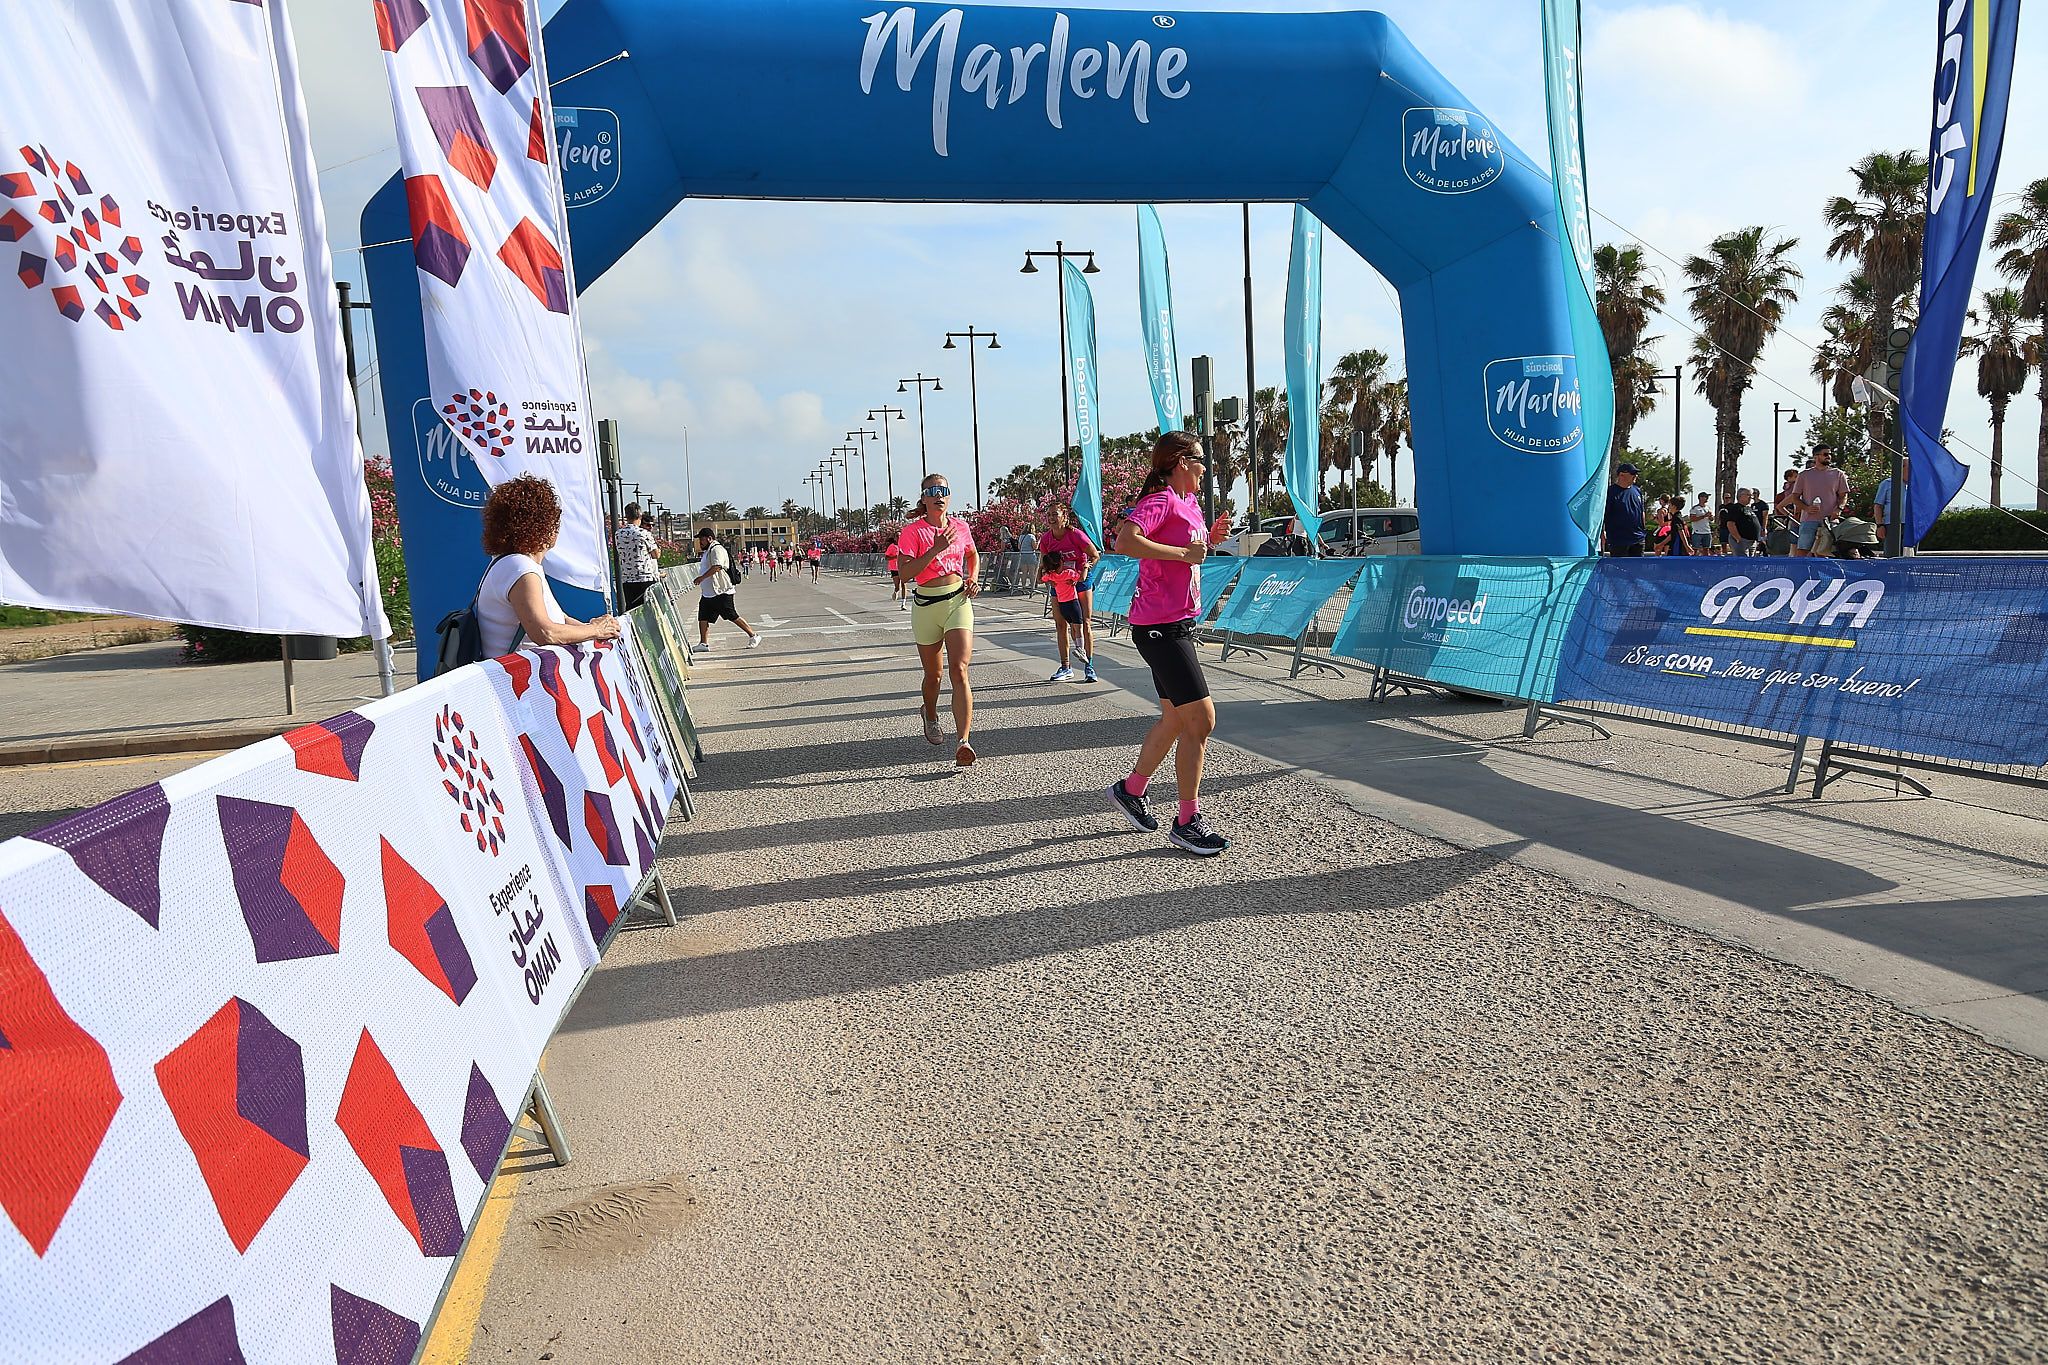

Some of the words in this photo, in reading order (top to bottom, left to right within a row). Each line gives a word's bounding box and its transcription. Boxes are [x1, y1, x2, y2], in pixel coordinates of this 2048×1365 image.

[859, 6, 1191, 157] Marlene
[558, 128, 612, 172] lene
[1411, 126, 1496, 171] Marlene
[573, 182, 604, 201] ALPES
[1416, 170, 1435, 186] HIJA
[1437, 179, 1450, 188] DE
[1451, 179, 1469, 188] LOS
[1471, 167, 1495, 185] ALPES
[1504, 428, 1525, 444] HIJA
[1528, 438, 1541, 447] DE
[1544, 438, 1561, 447] LOS
[1562, 425, 1581, 445] ALPES
[436, 479, 460, 497] HIJA
[464, 491, 480, 501] DE
[1403, 585, 1488, 628] Compeed
[1700, 575, 1885, 628] GOYA
[1644, 655, 1665, 667] es
[1664, 653, 1714, 673] GOYA
[1760, 668, 1801, 694] que
[1802, 673, 1838, 689] ser
[1839, 666, 1921, 698] bueno!
[489, 863, 532, 916] Experience
[524, 931, 562, 1006] OMAN
